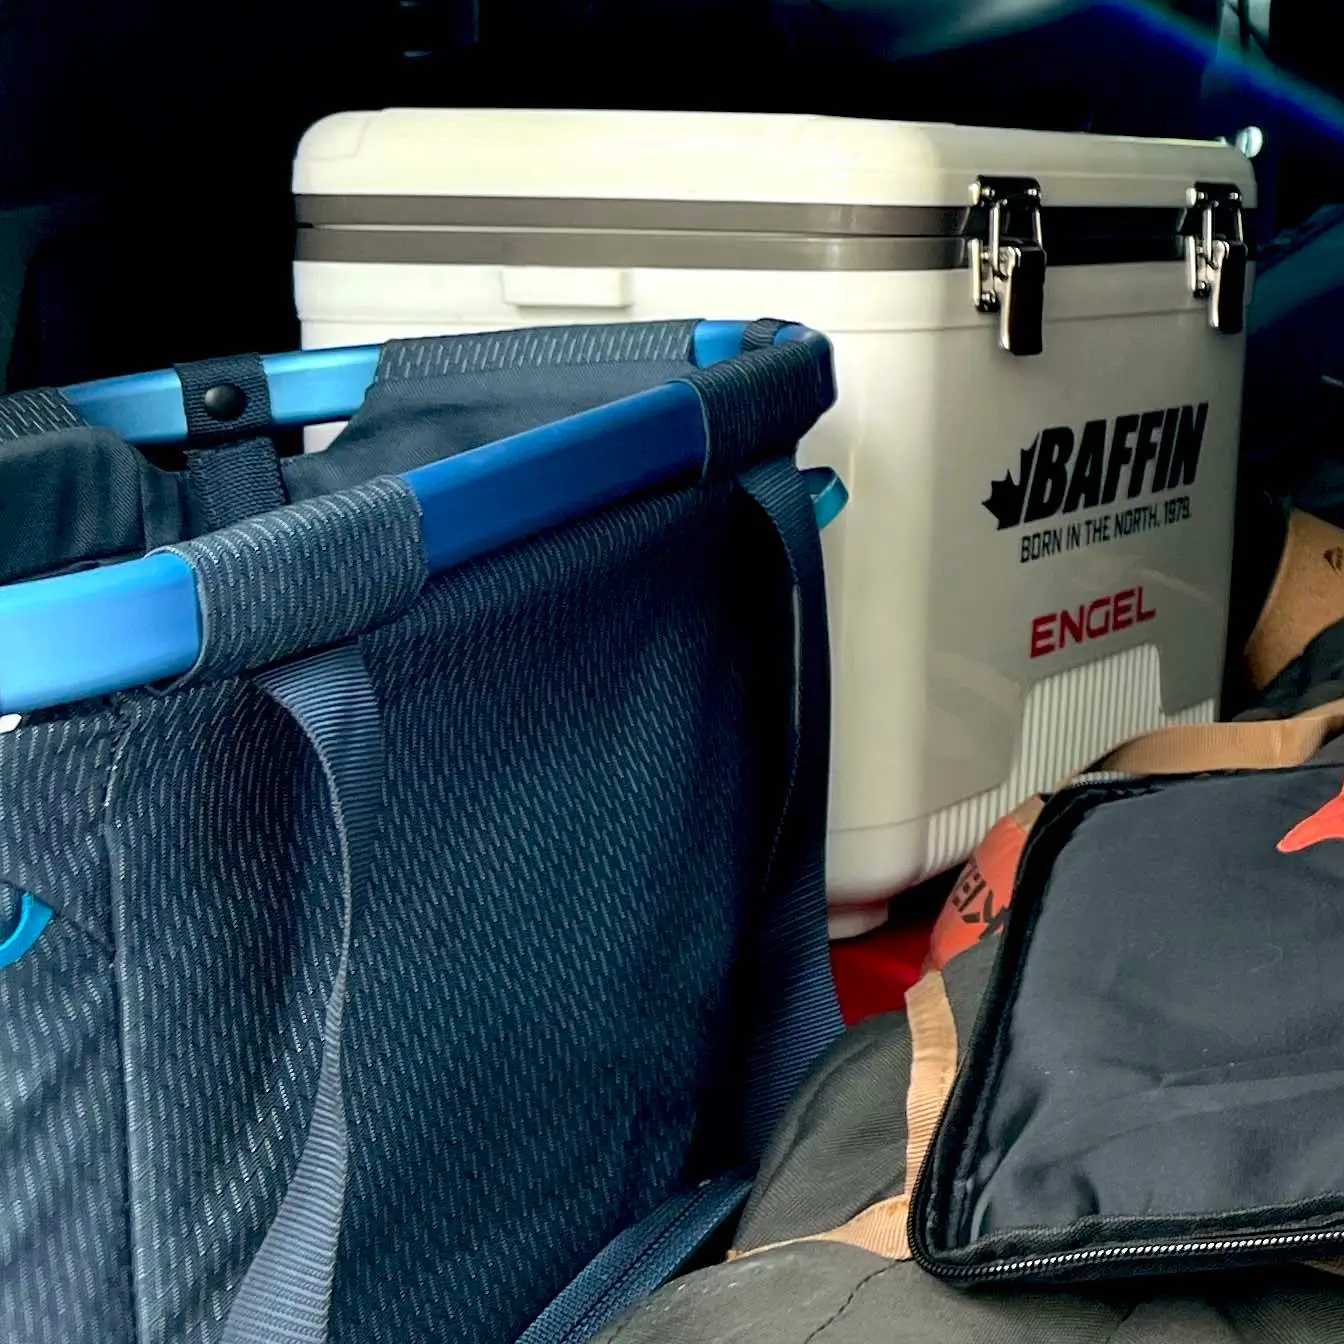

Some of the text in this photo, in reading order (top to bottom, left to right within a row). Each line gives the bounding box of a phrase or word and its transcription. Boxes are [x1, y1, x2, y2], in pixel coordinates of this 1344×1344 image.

[1024, 403, 1209, 524] BAFFIN
[1020, 527, 1063, 563] BORN
[1066, 522, 1082, 551] IN
[1085, 516, 1113, 545] THE
[1030, 586, 1156, 658] ENGEL
